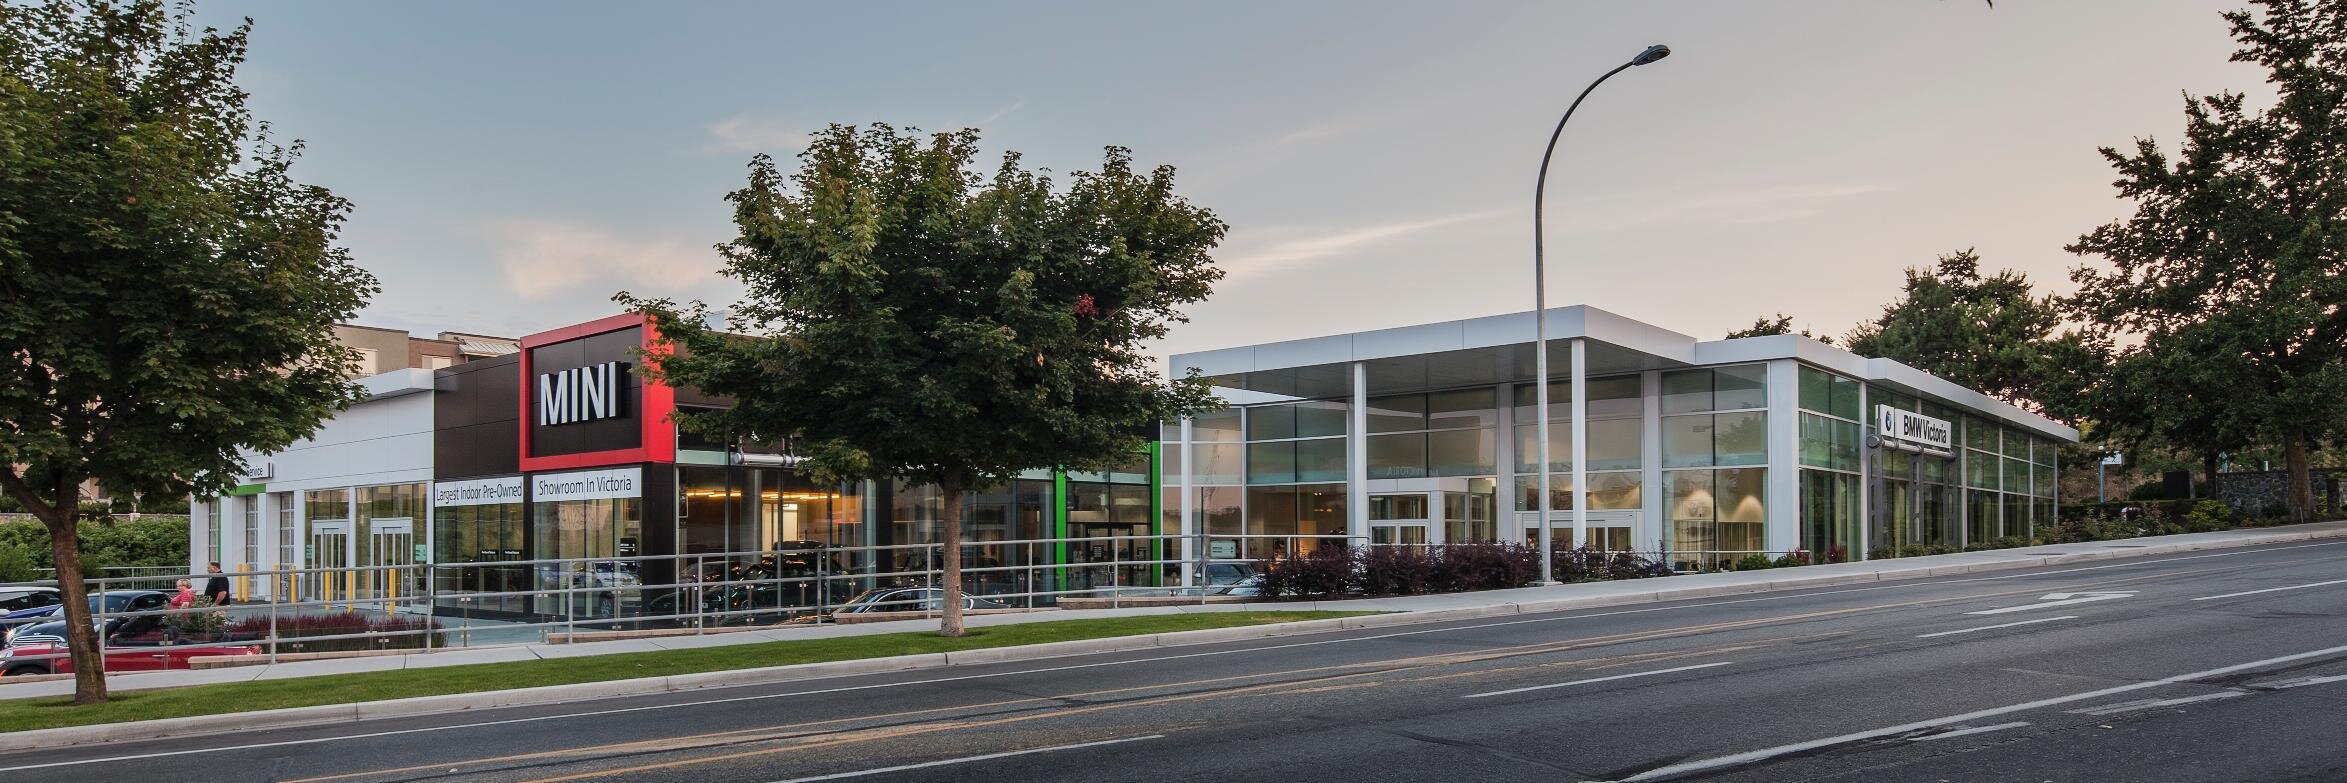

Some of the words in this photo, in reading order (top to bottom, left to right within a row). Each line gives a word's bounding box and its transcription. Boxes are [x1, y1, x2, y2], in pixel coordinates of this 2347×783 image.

[540, 361, 616, 426] MINI
[1904, 415, 1922, 438] BMW
[1922, 419, 1946, 443] Victoria
[436, 487, 459, 504] Largest
[461, 485, 481, 500] Indoor
[483, 482, 522, 498] Pre-Owned
[539, 479, 584, 496] Showroom
[586, 477, 595, 493] In
[596, 475, 632, 492] Victoria
